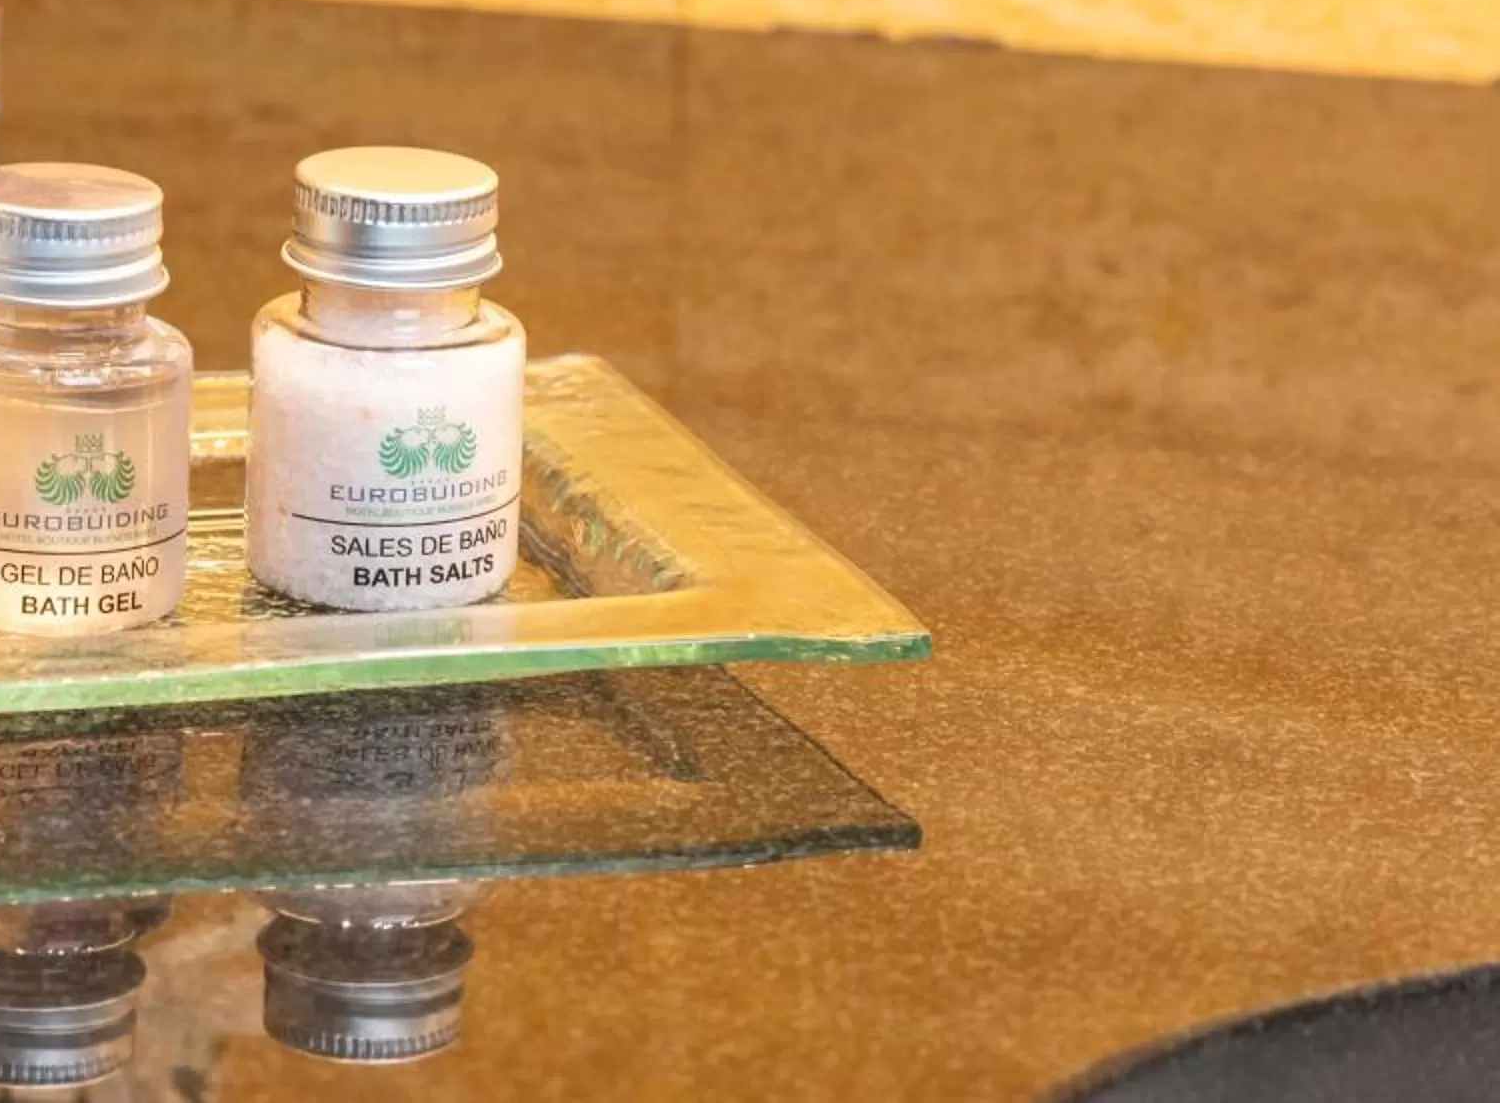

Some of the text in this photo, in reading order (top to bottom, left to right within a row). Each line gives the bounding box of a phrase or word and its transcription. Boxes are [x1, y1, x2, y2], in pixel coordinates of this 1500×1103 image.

[329, 469, 508, 504] EUROBUIDING
[331, 518, 507, 558] SALES DE BAÑO
[0, 555, 159, 586] GEL DE BAÑO
[353, 553, 495, 588] BATH SALTS
[21, 591, 143, 616] BATH GEL
